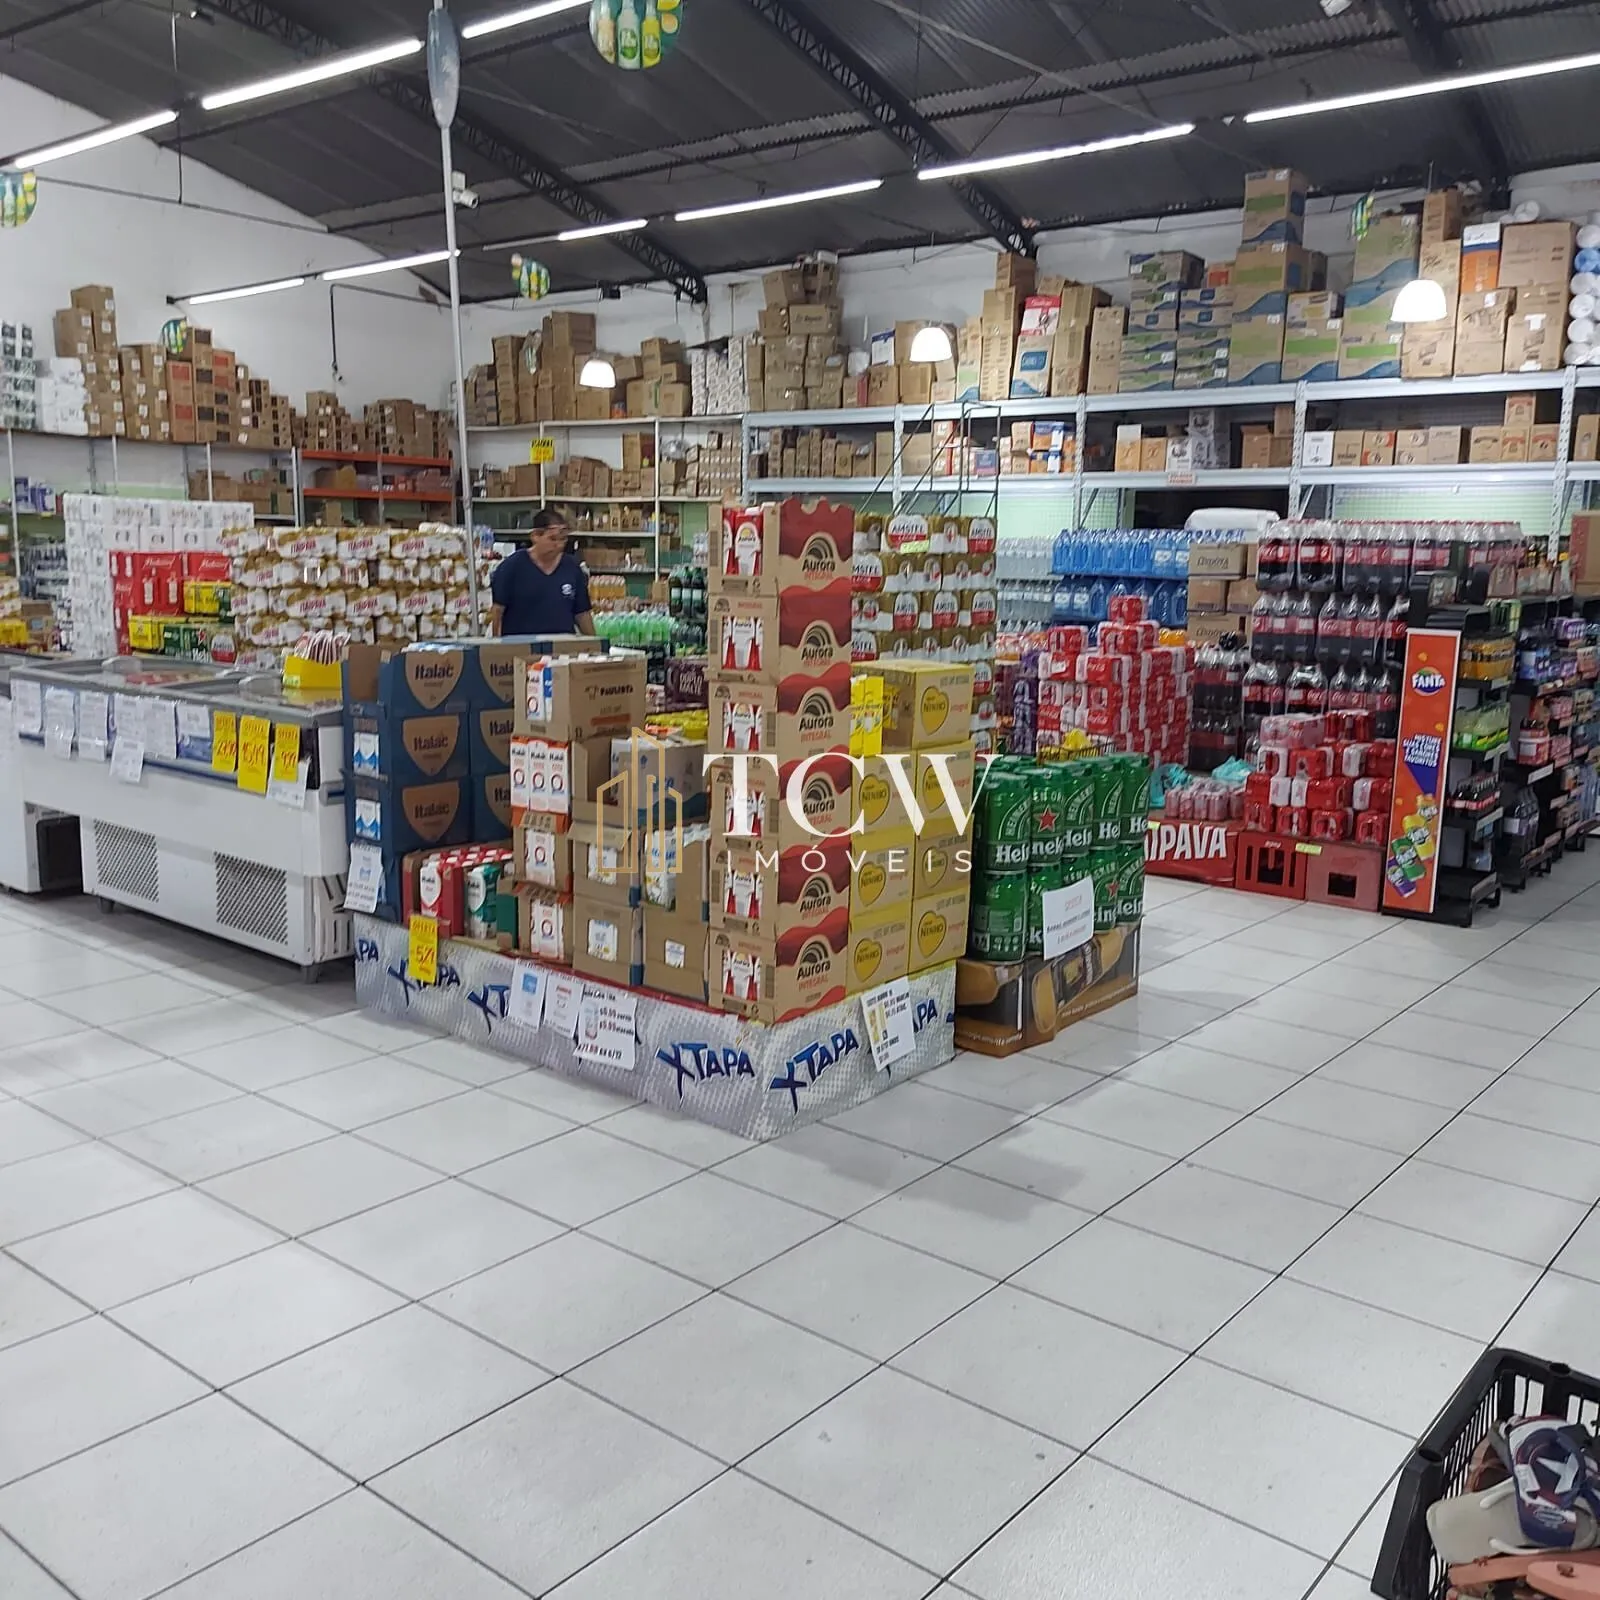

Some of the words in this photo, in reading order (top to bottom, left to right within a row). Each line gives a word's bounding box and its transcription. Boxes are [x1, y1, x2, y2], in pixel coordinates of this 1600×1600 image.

[802, 558, 835, 572] Aurora
[801, 647, 833, 661] Aurora
[415, 663, 453, 680] Italac
[600, 684, 634, 696] PAULISTA
[1412, 673, 1446, 690] FANTA
[924, 700, 946, 712] NINHO
[799, 715, 834, 731] Aurora
[414, 734, 448, 751] Italac
[801, 732, 832, 743] INTEGRAL
[414, 801, 450, 819] Italac
[800, 895, 831, 912] Aurora
[921, 924, 944, 937] NINHO
[354, 938, 379, 962] PA
[797, 960, 831, 980] Aurora
[656, 1042, 755, 1102] XTAPA
[769, 1028, 860, 1115] XTAPA
